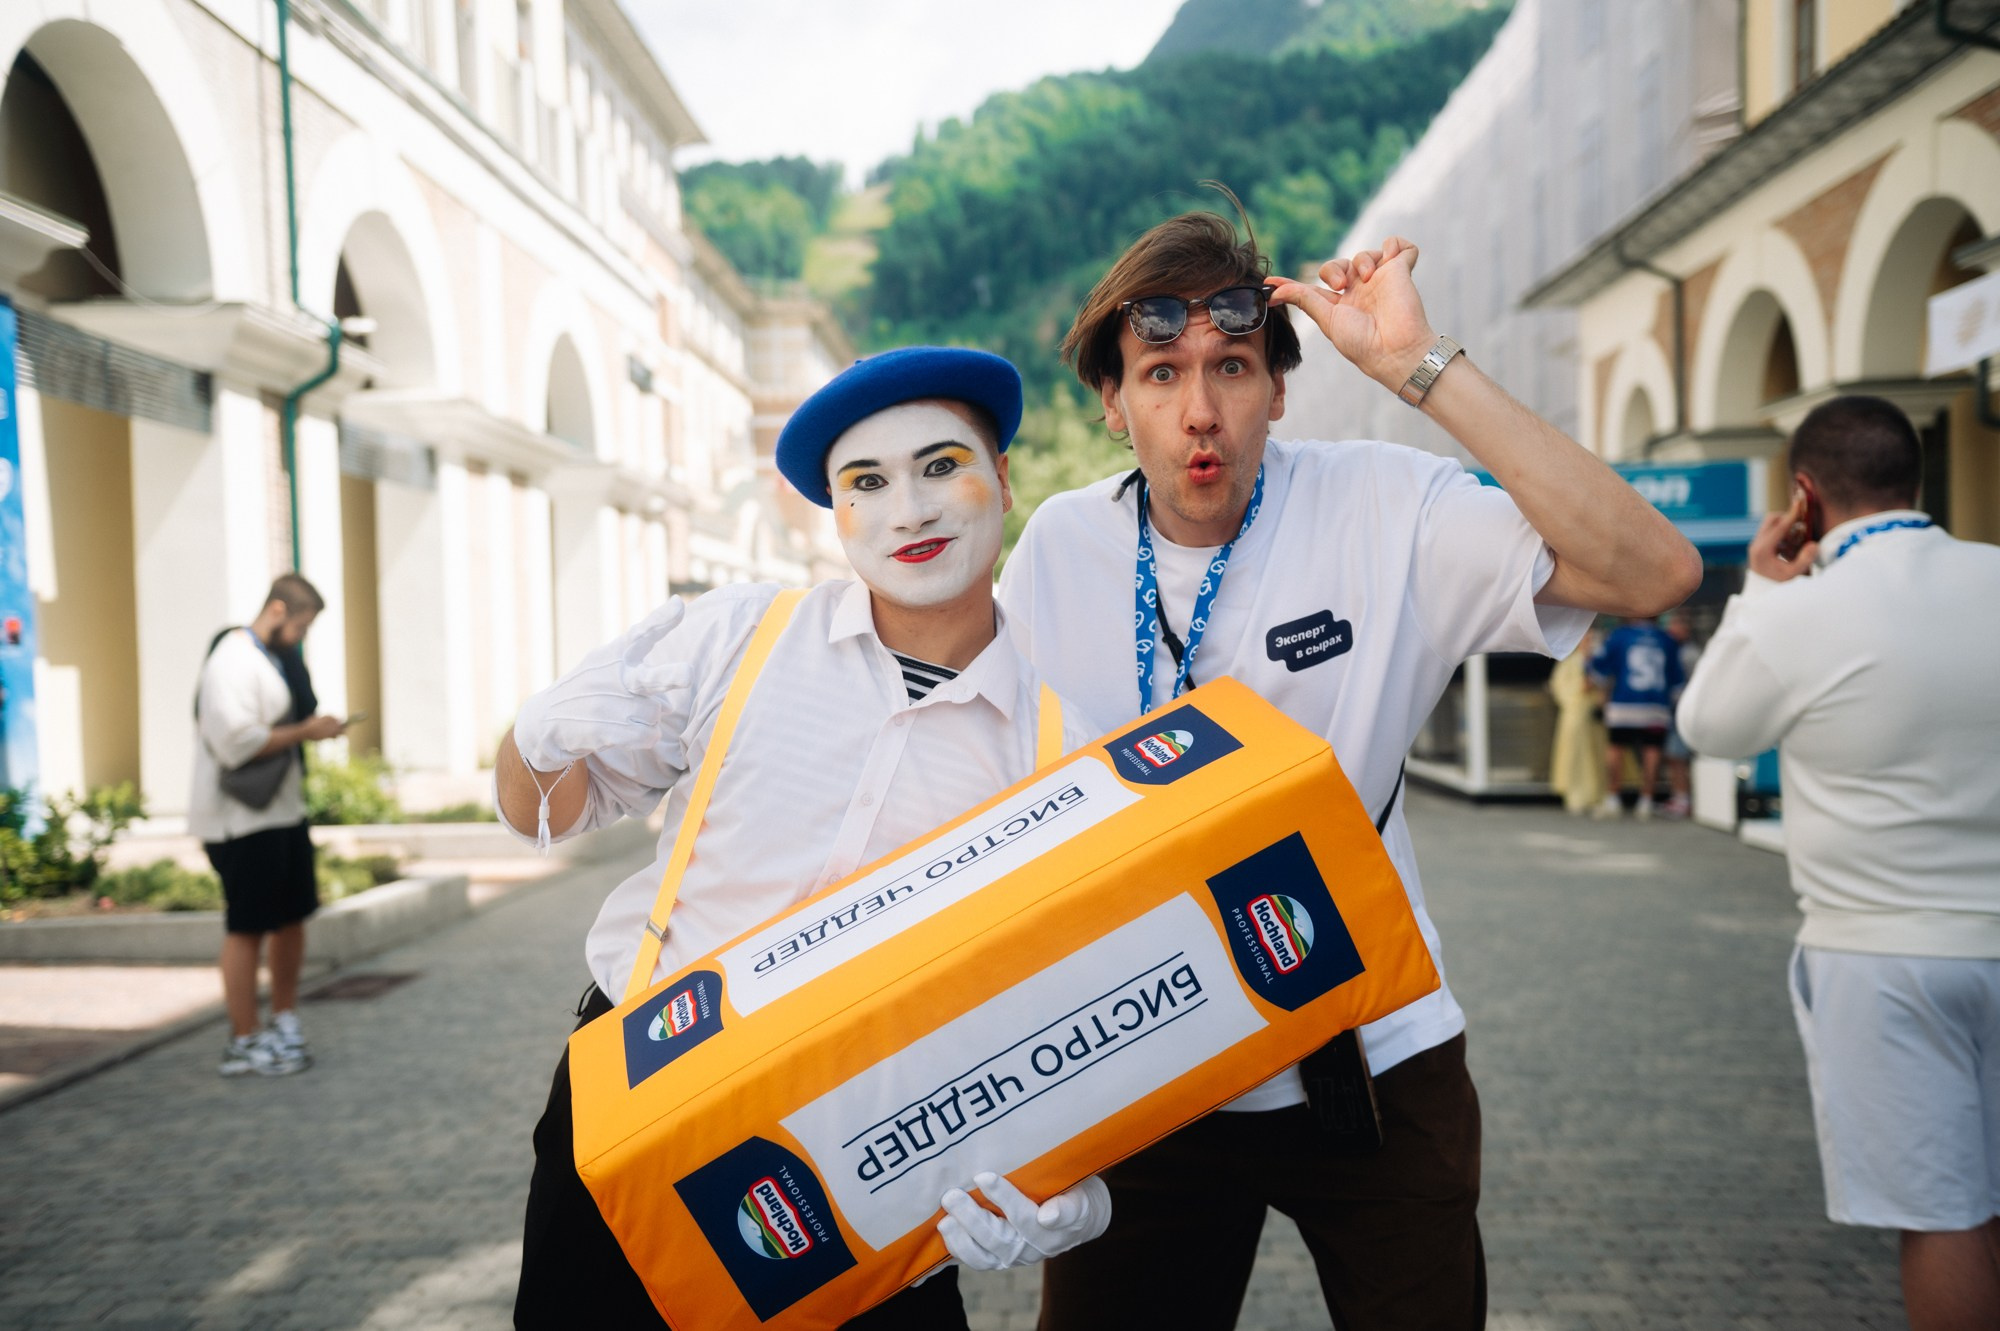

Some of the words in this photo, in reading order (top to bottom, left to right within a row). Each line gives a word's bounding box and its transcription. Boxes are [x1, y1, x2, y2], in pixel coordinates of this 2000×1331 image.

[1275, 624, 1326, 648] Эксперт
[1296, 650, 1303, 659] в
[1305, 634, 1343, 656] сырах
[1121, 748, 1152, 776] PROFESSIONAL
[1141, 738, 1174, 763] Hochland
[925, 785, 1085, 880] БИСТРО
[753, 884, 914, 973] ЧЕДДЕР
[1232, 907, 1275, 985] PROFESSIONAL
[1254, 901, 1296, 968] Hochland
[1030, 963, 1203, 1076] БИСТРО
[856, 1072, 1025, 1182] ЧЕДДЕР
[755, 1183, 806, 1253] Hochland
[779, 1164, 830, 1243] PROFESSIONAL
